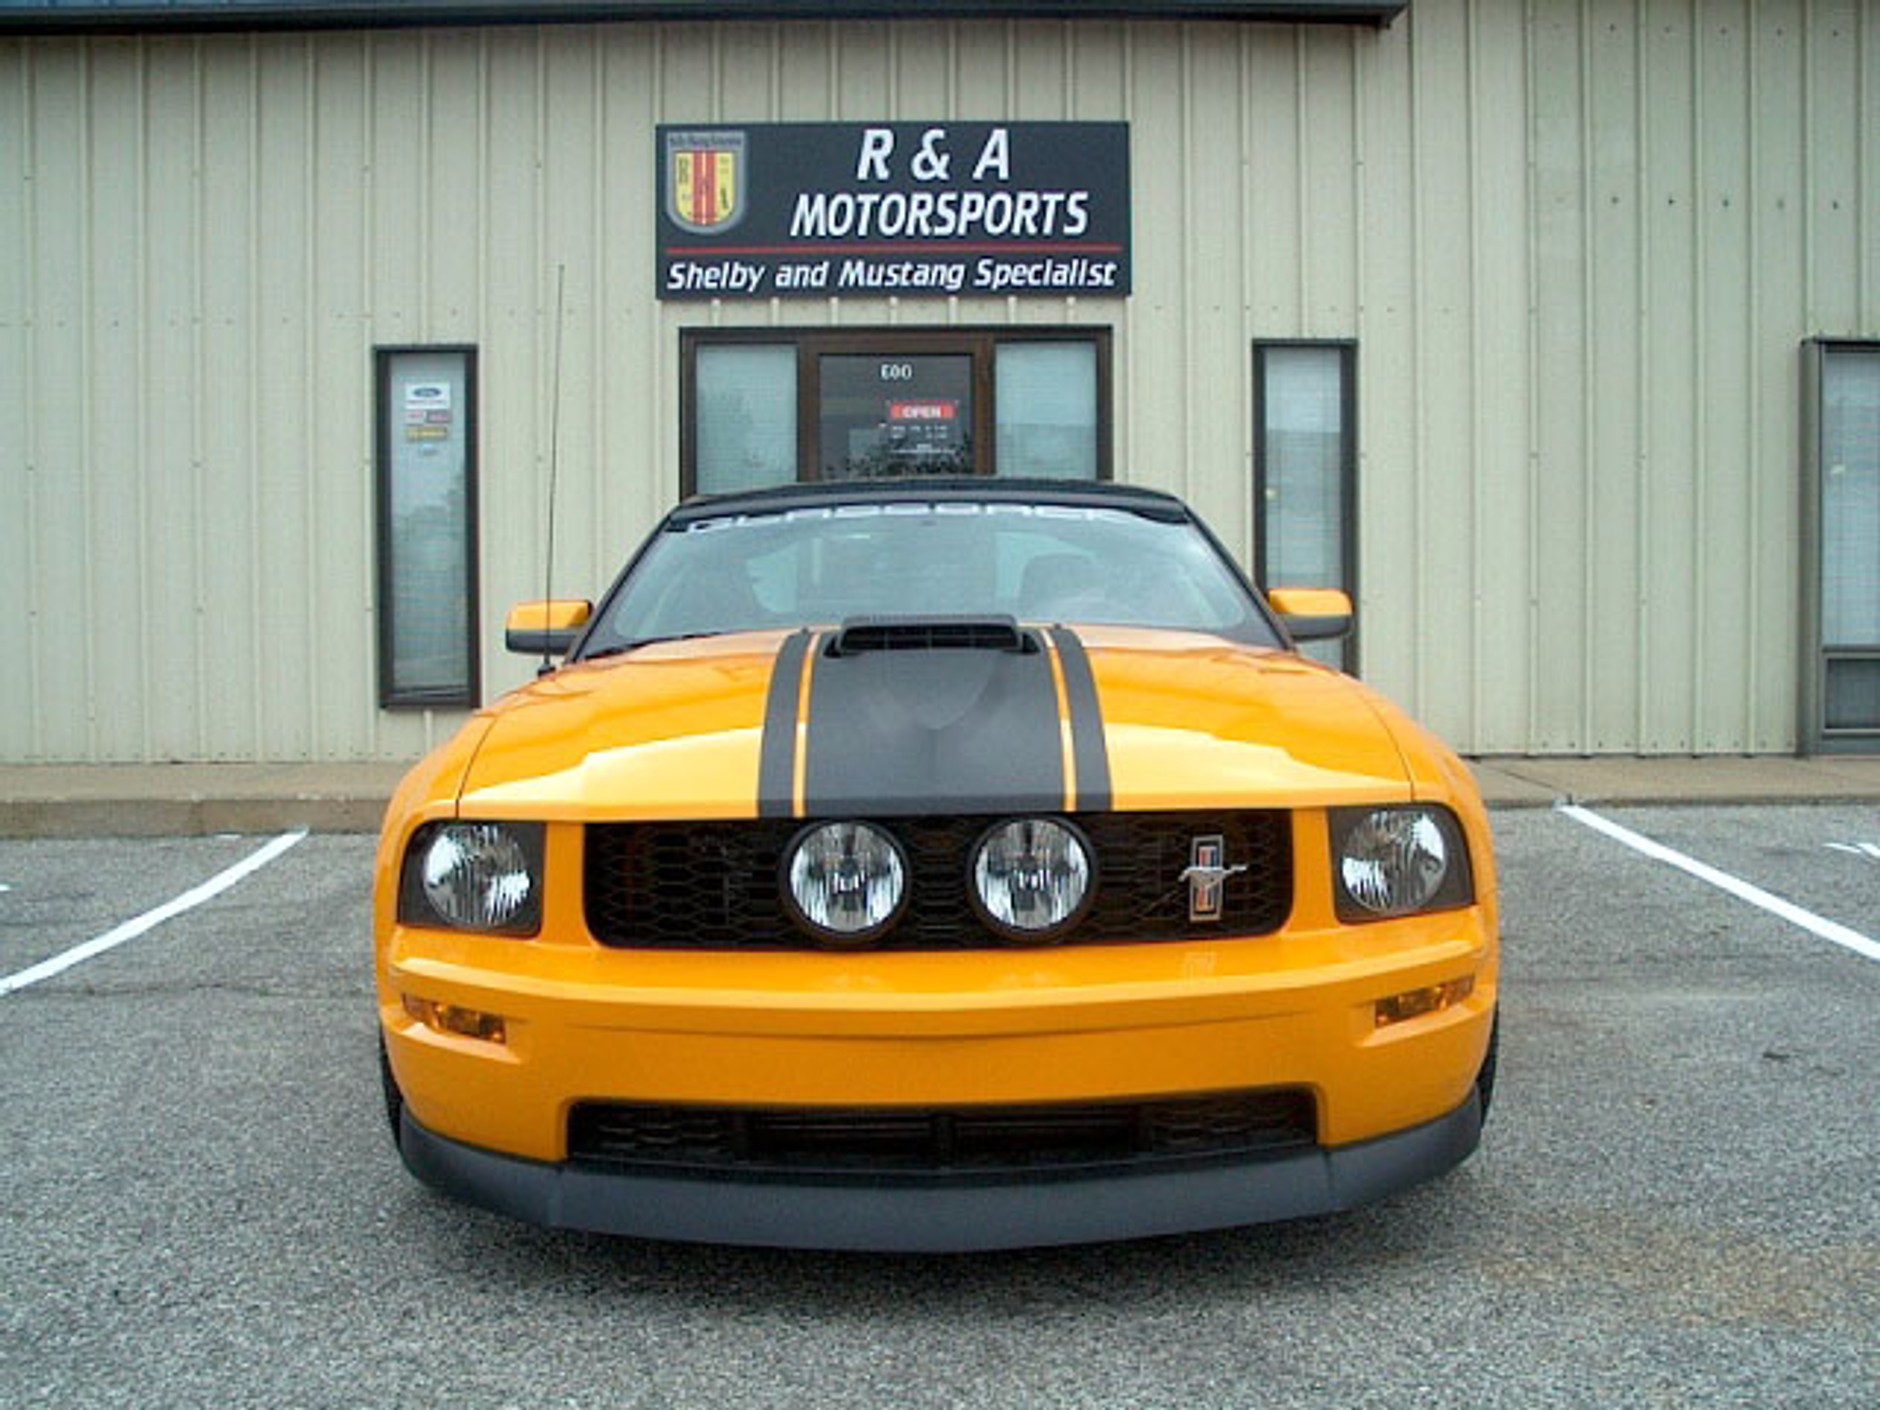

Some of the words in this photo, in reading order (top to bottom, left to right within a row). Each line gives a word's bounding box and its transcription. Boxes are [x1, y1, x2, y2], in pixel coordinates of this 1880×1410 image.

[857, 128, 894, 180] R
[911, 128, 950, 181] &
[972, 128, 1010, 180] A
[789, 191, 1089, 237] MOTORSPORTS
[666, 261, 766, 292] Shelby
[775, 260, 829, 288] and
[837, 259, 965, 291] Mustang
[973, 258, 1117, 290] Specialist
